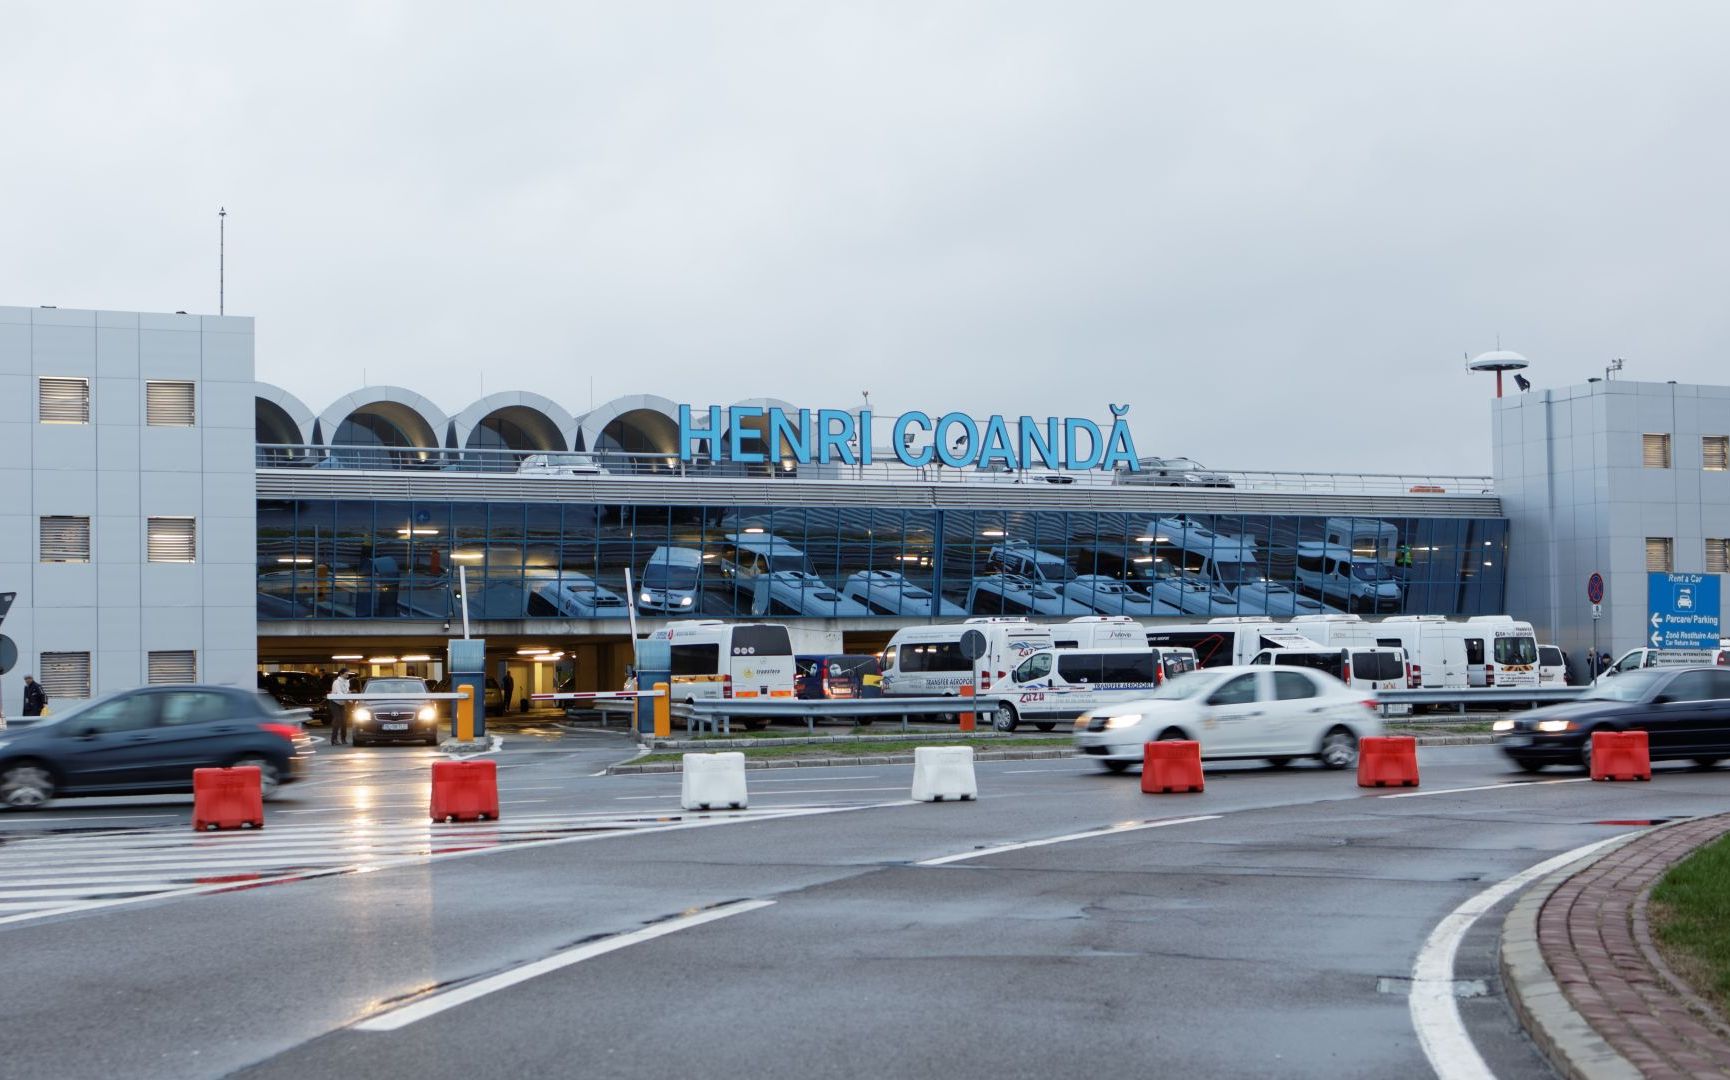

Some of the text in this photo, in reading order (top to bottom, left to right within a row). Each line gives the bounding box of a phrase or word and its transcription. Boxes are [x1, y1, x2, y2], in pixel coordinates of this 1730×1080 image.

[678, 403, 1140, 473] HENRI COANDĂ
[1668, 574, 1684, 583] Rent
[1690, 574, 1703, 583] Car
[1693, 615, 1718, 626] Parking
[1680, 631, 1706, 640] Restituire
[1707, 632, 1720, 640] Auto
[1019, 692, 1045, 703] Zuzu
